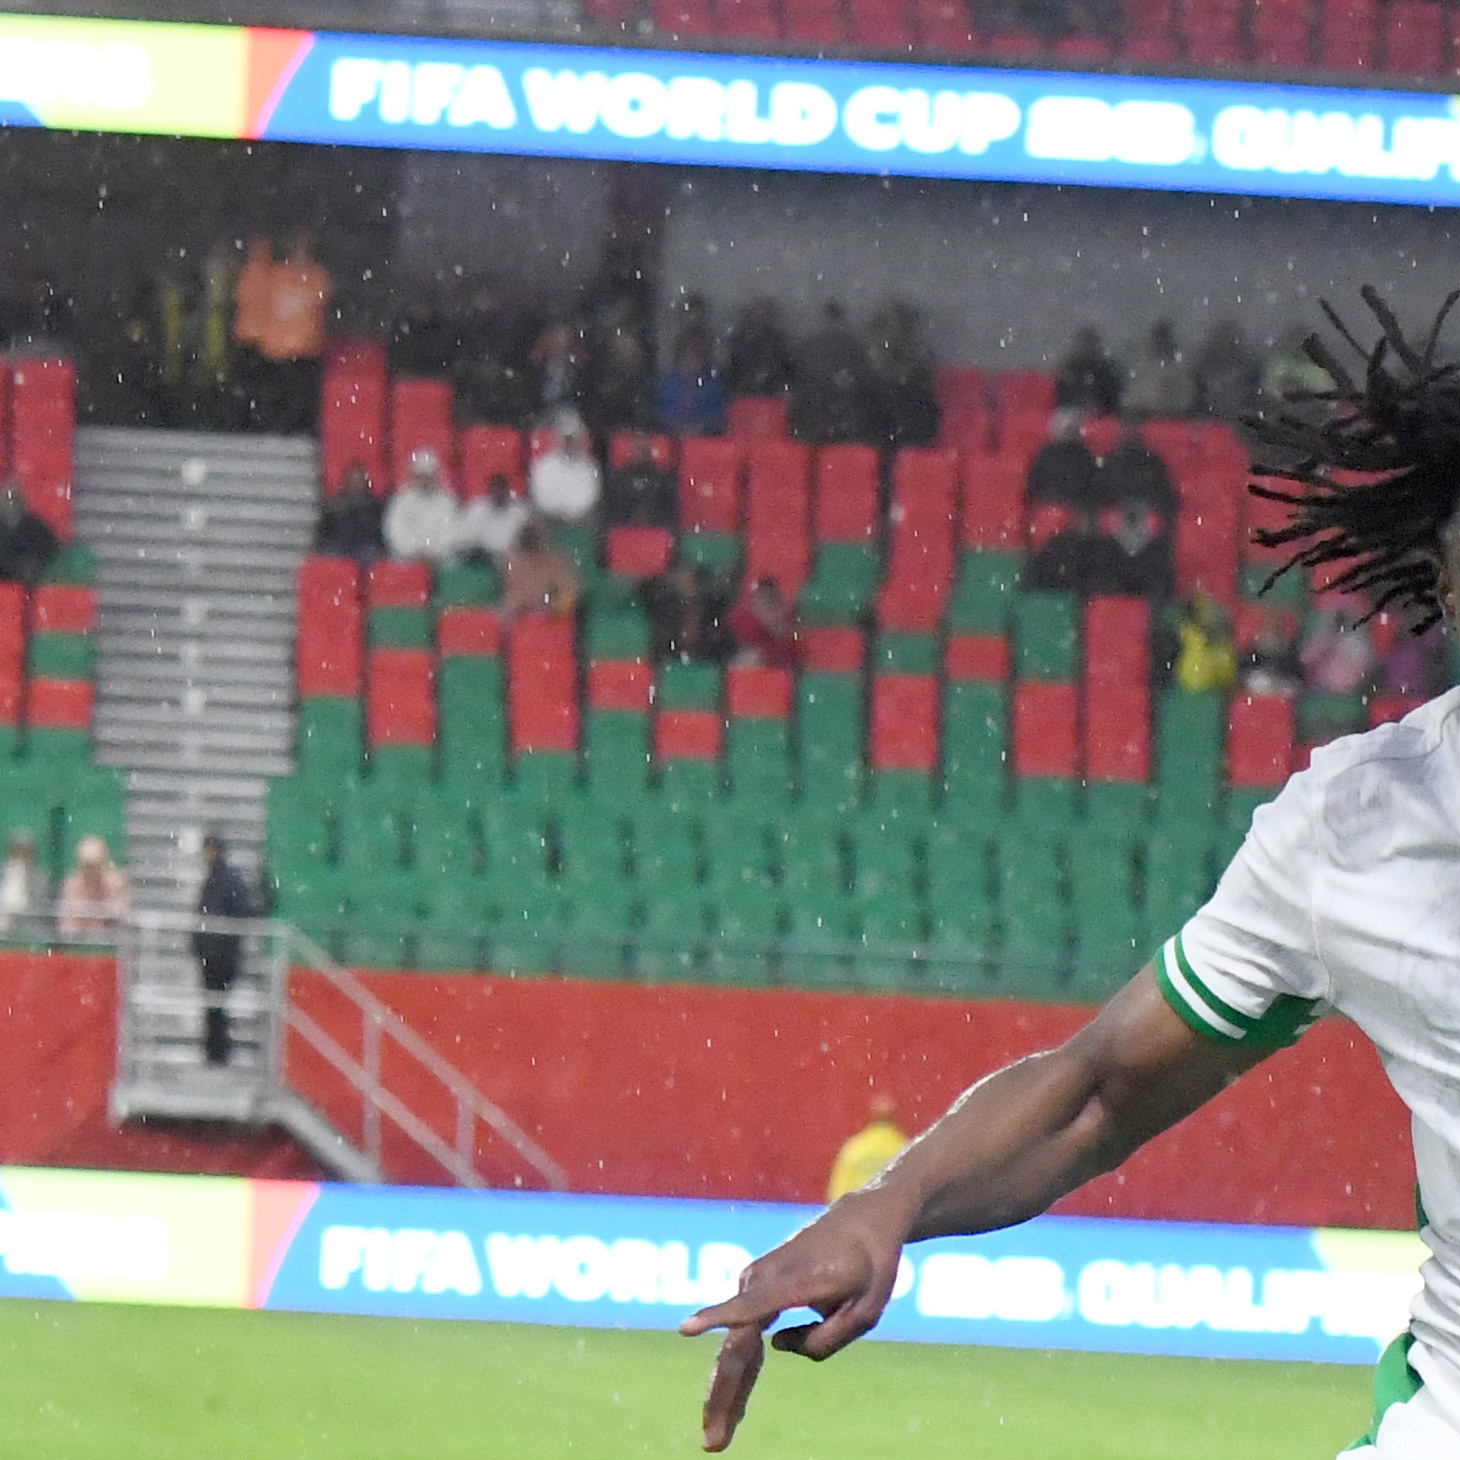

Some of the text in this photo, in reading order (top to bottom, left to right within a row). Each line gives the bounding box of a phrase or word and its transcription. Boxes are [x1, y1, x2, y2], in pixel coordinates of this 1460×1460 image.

[330, 58, 517, 128] FIFA
[523, 68, 838, 147] WORLD
[843, 86, 1021, 155] CUP
[320, 1226, 752, 1305] FIFA WORLD
